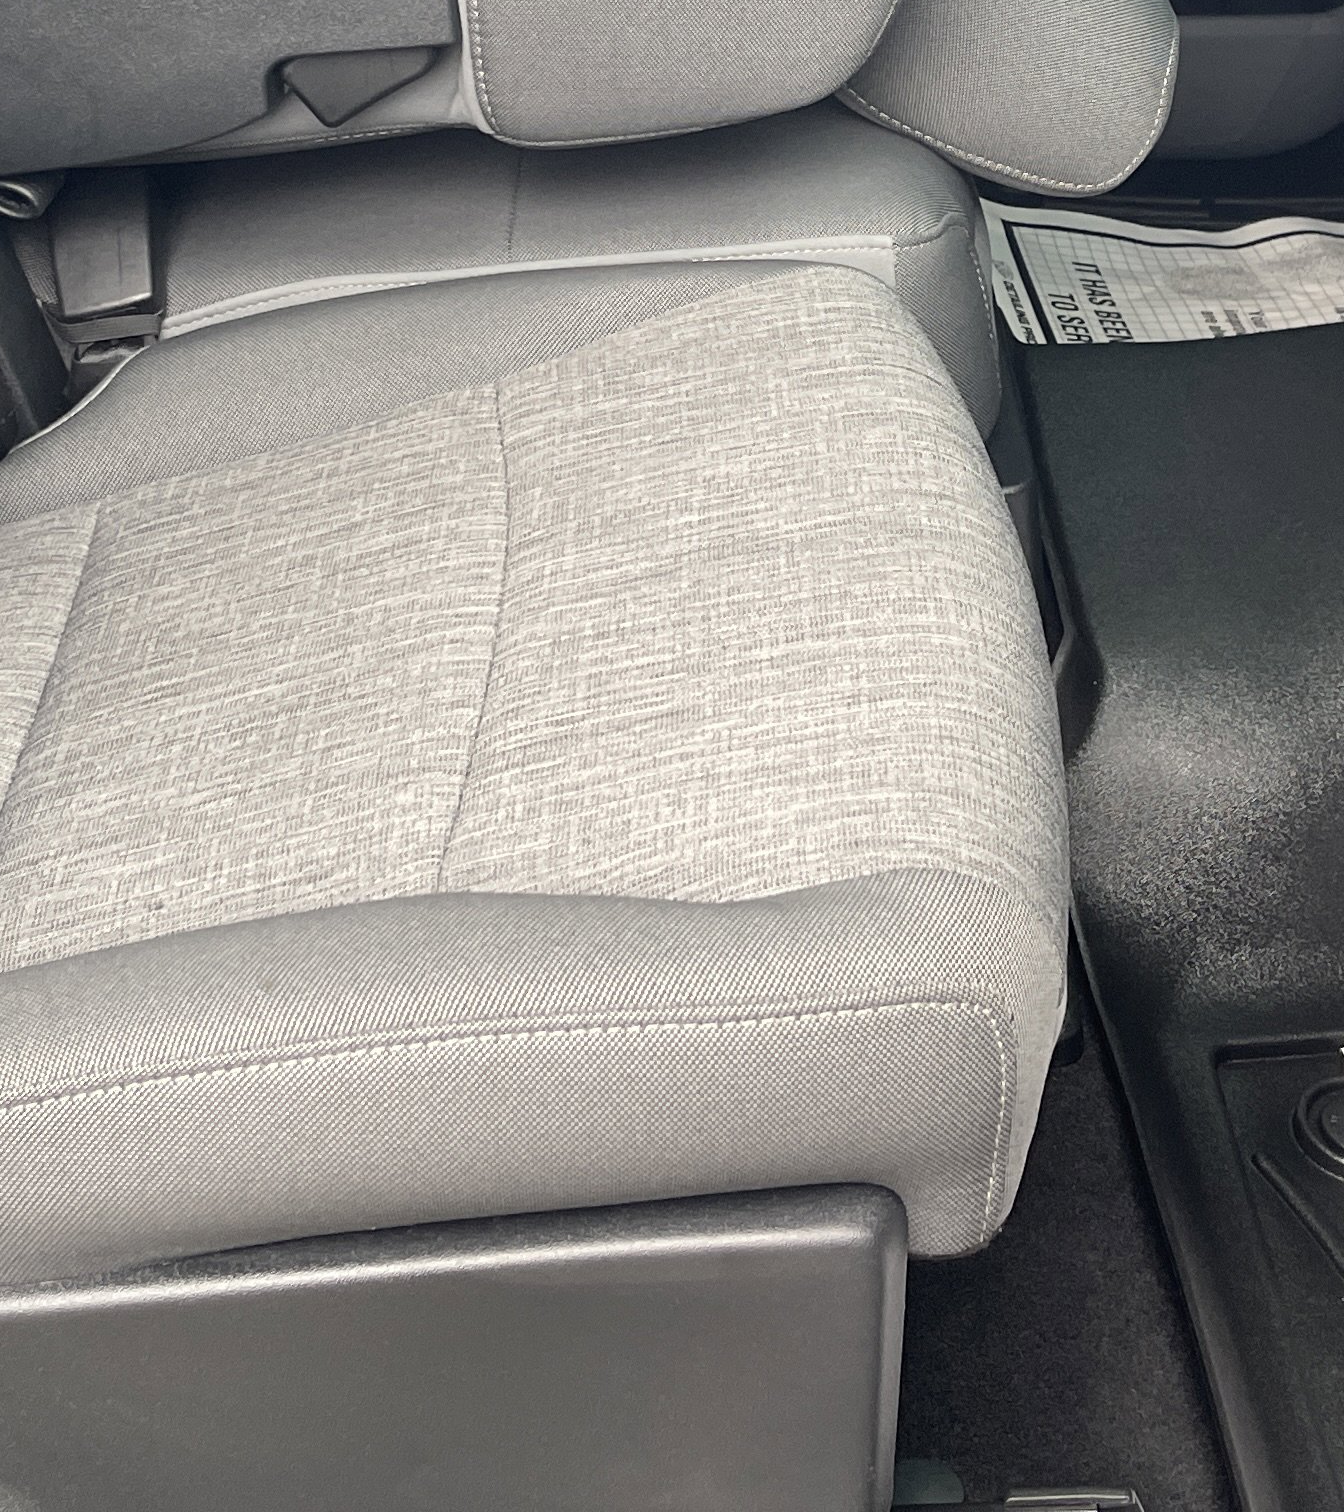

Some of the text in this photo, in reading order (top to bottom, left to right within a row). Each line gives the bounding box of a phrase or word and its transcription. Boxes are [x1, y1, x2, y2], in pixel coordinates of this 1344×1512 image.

[1072, 261, 1102, 276] IT
[1080, 278, 1116, 307] HAS
[1048, 293, 1079, 311] TO
